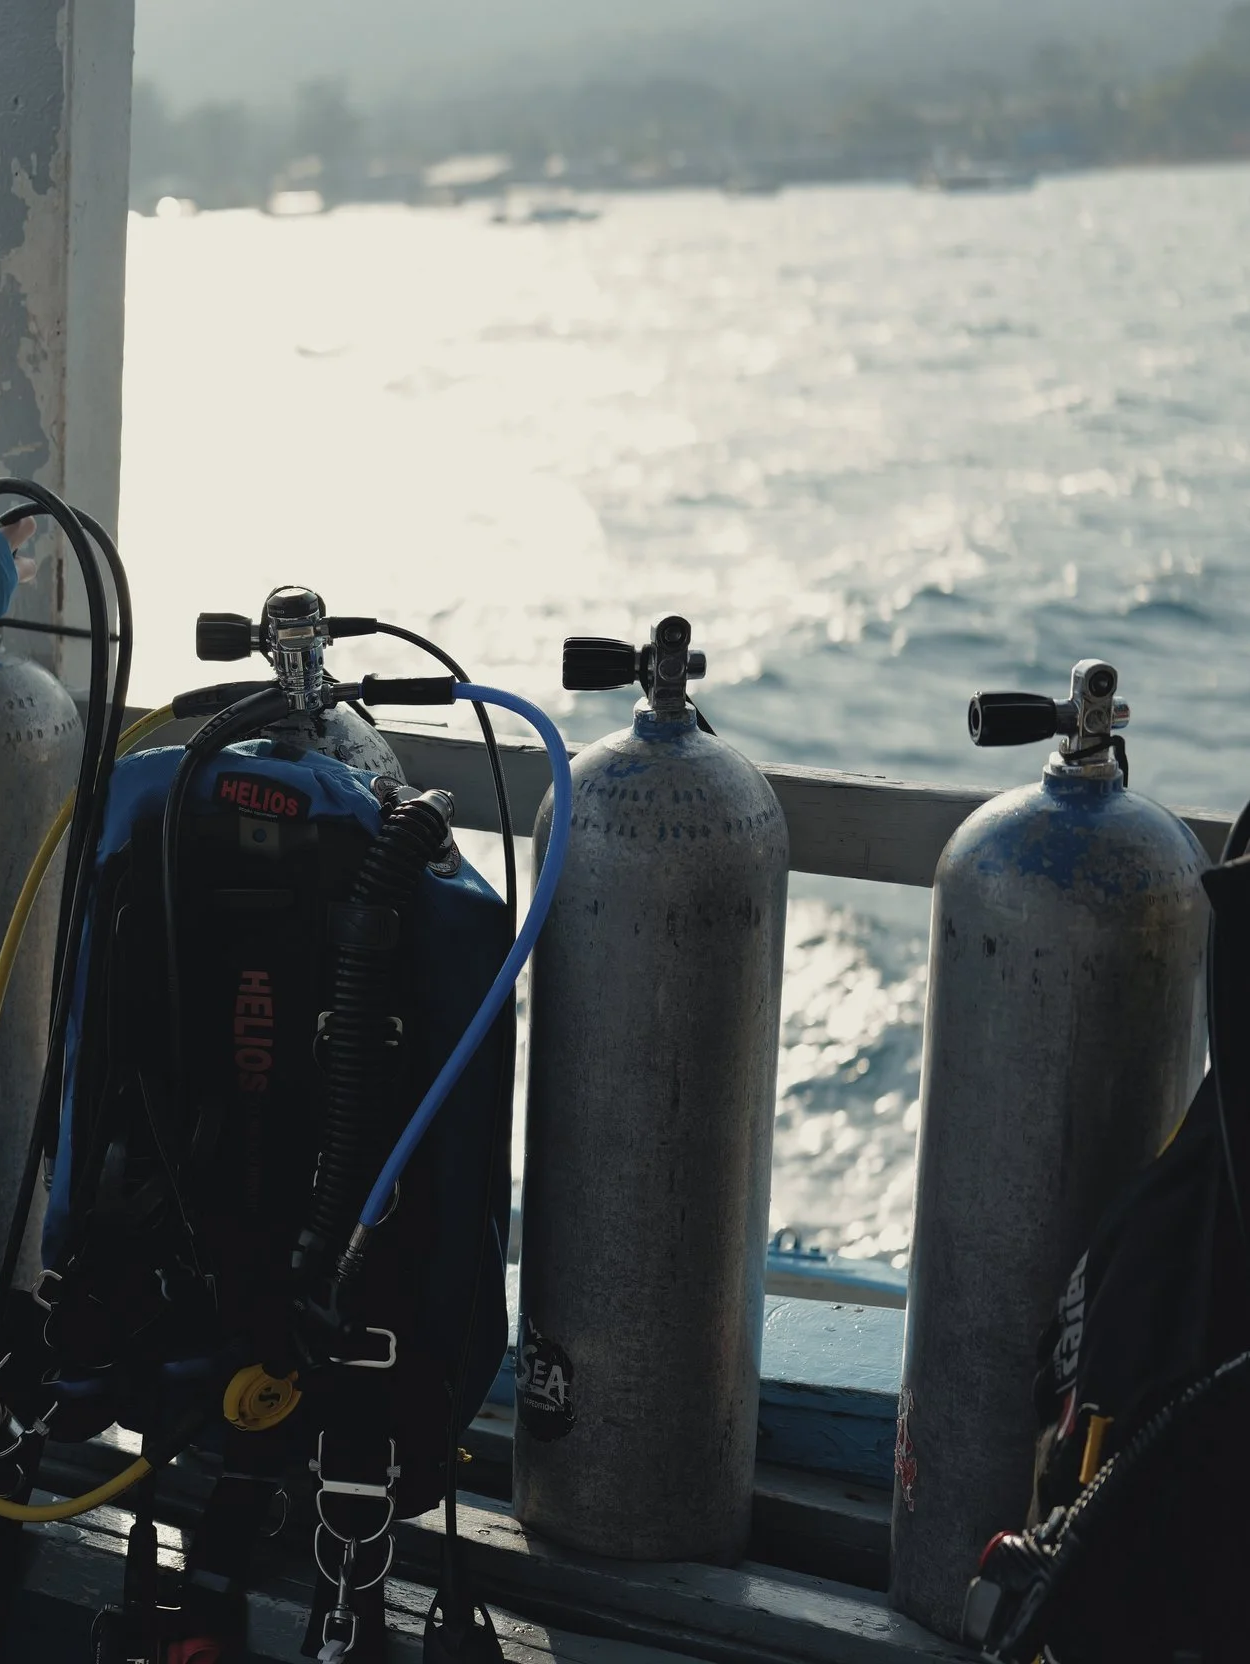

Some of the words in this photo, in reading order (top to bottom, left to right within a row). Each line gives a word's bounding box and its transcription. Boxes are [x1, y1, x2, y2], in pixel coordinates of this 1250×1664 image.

[219, 779, 299, 817] HELIOS
[233, 969, 274, 1093] HELIOS
[516, 1344, 571, 1406] SEA
